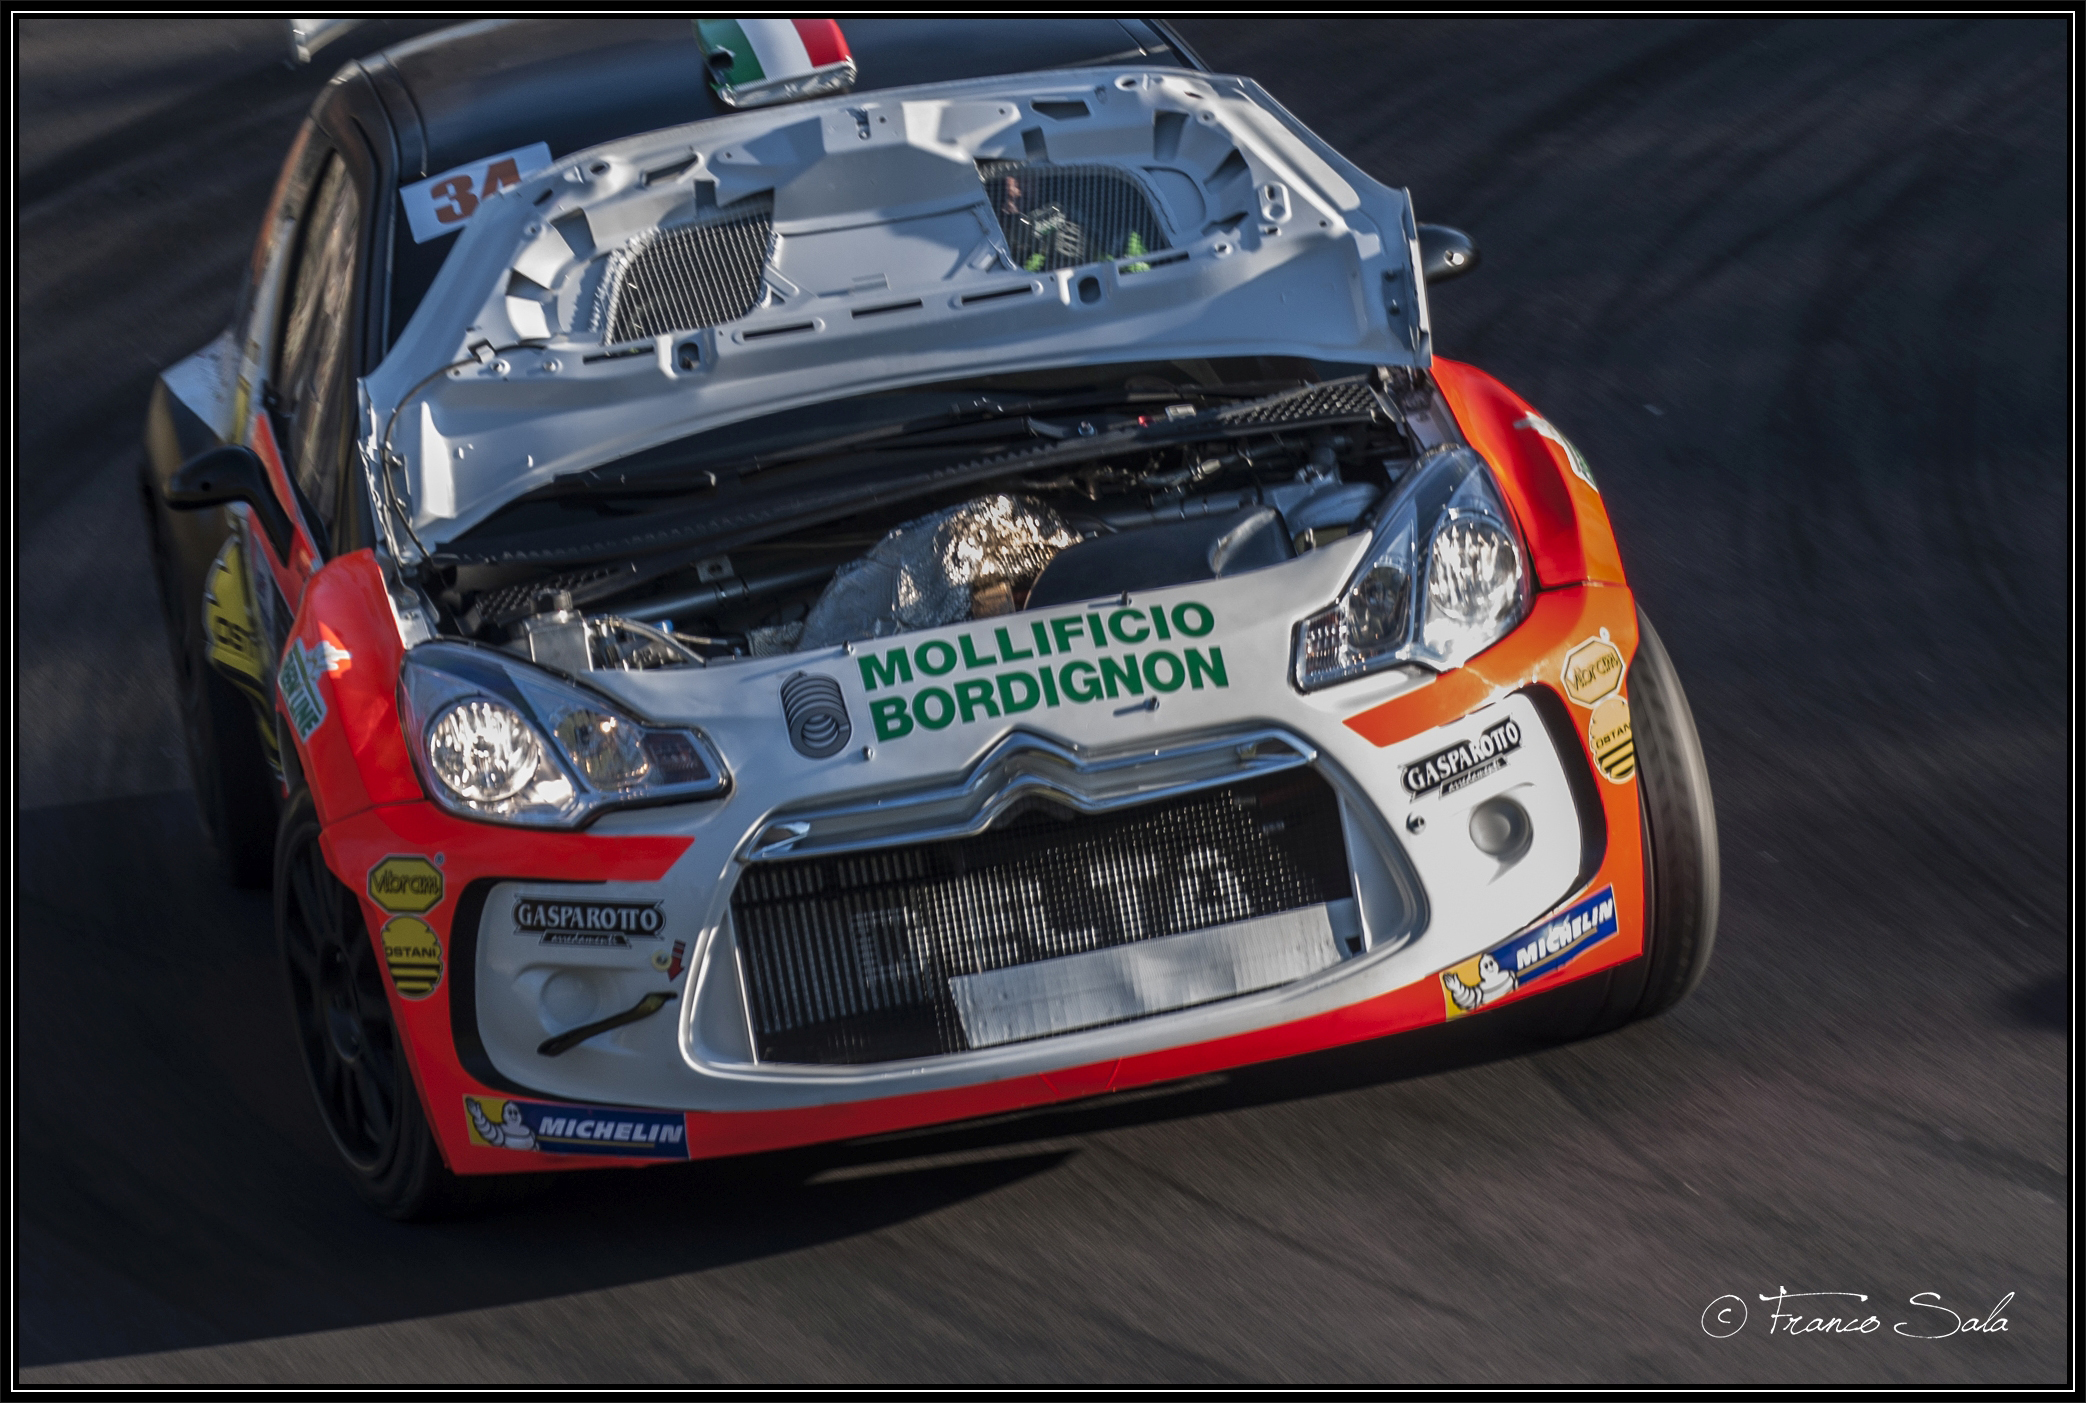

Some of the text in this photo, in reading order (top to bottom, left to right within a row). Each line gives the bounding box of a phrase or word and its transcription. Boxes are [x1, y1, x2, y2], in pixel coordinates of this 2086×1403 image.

[856, 601, 1215, 692] MOLLIFICIO
[869, 646, 1230, 743] BORDIGNON
[1407, 721, 1519, 791] GASPAROTTO
[1595, 722, 1631, 750] OSTAN
[518, 903, 659, 931] GASPAROTTO
[852, 846, 1254, 986] DELTA
[1516, 897, 1614, 971] MICHELIN
[538, 1116, 683, 1144] MICHELIN
